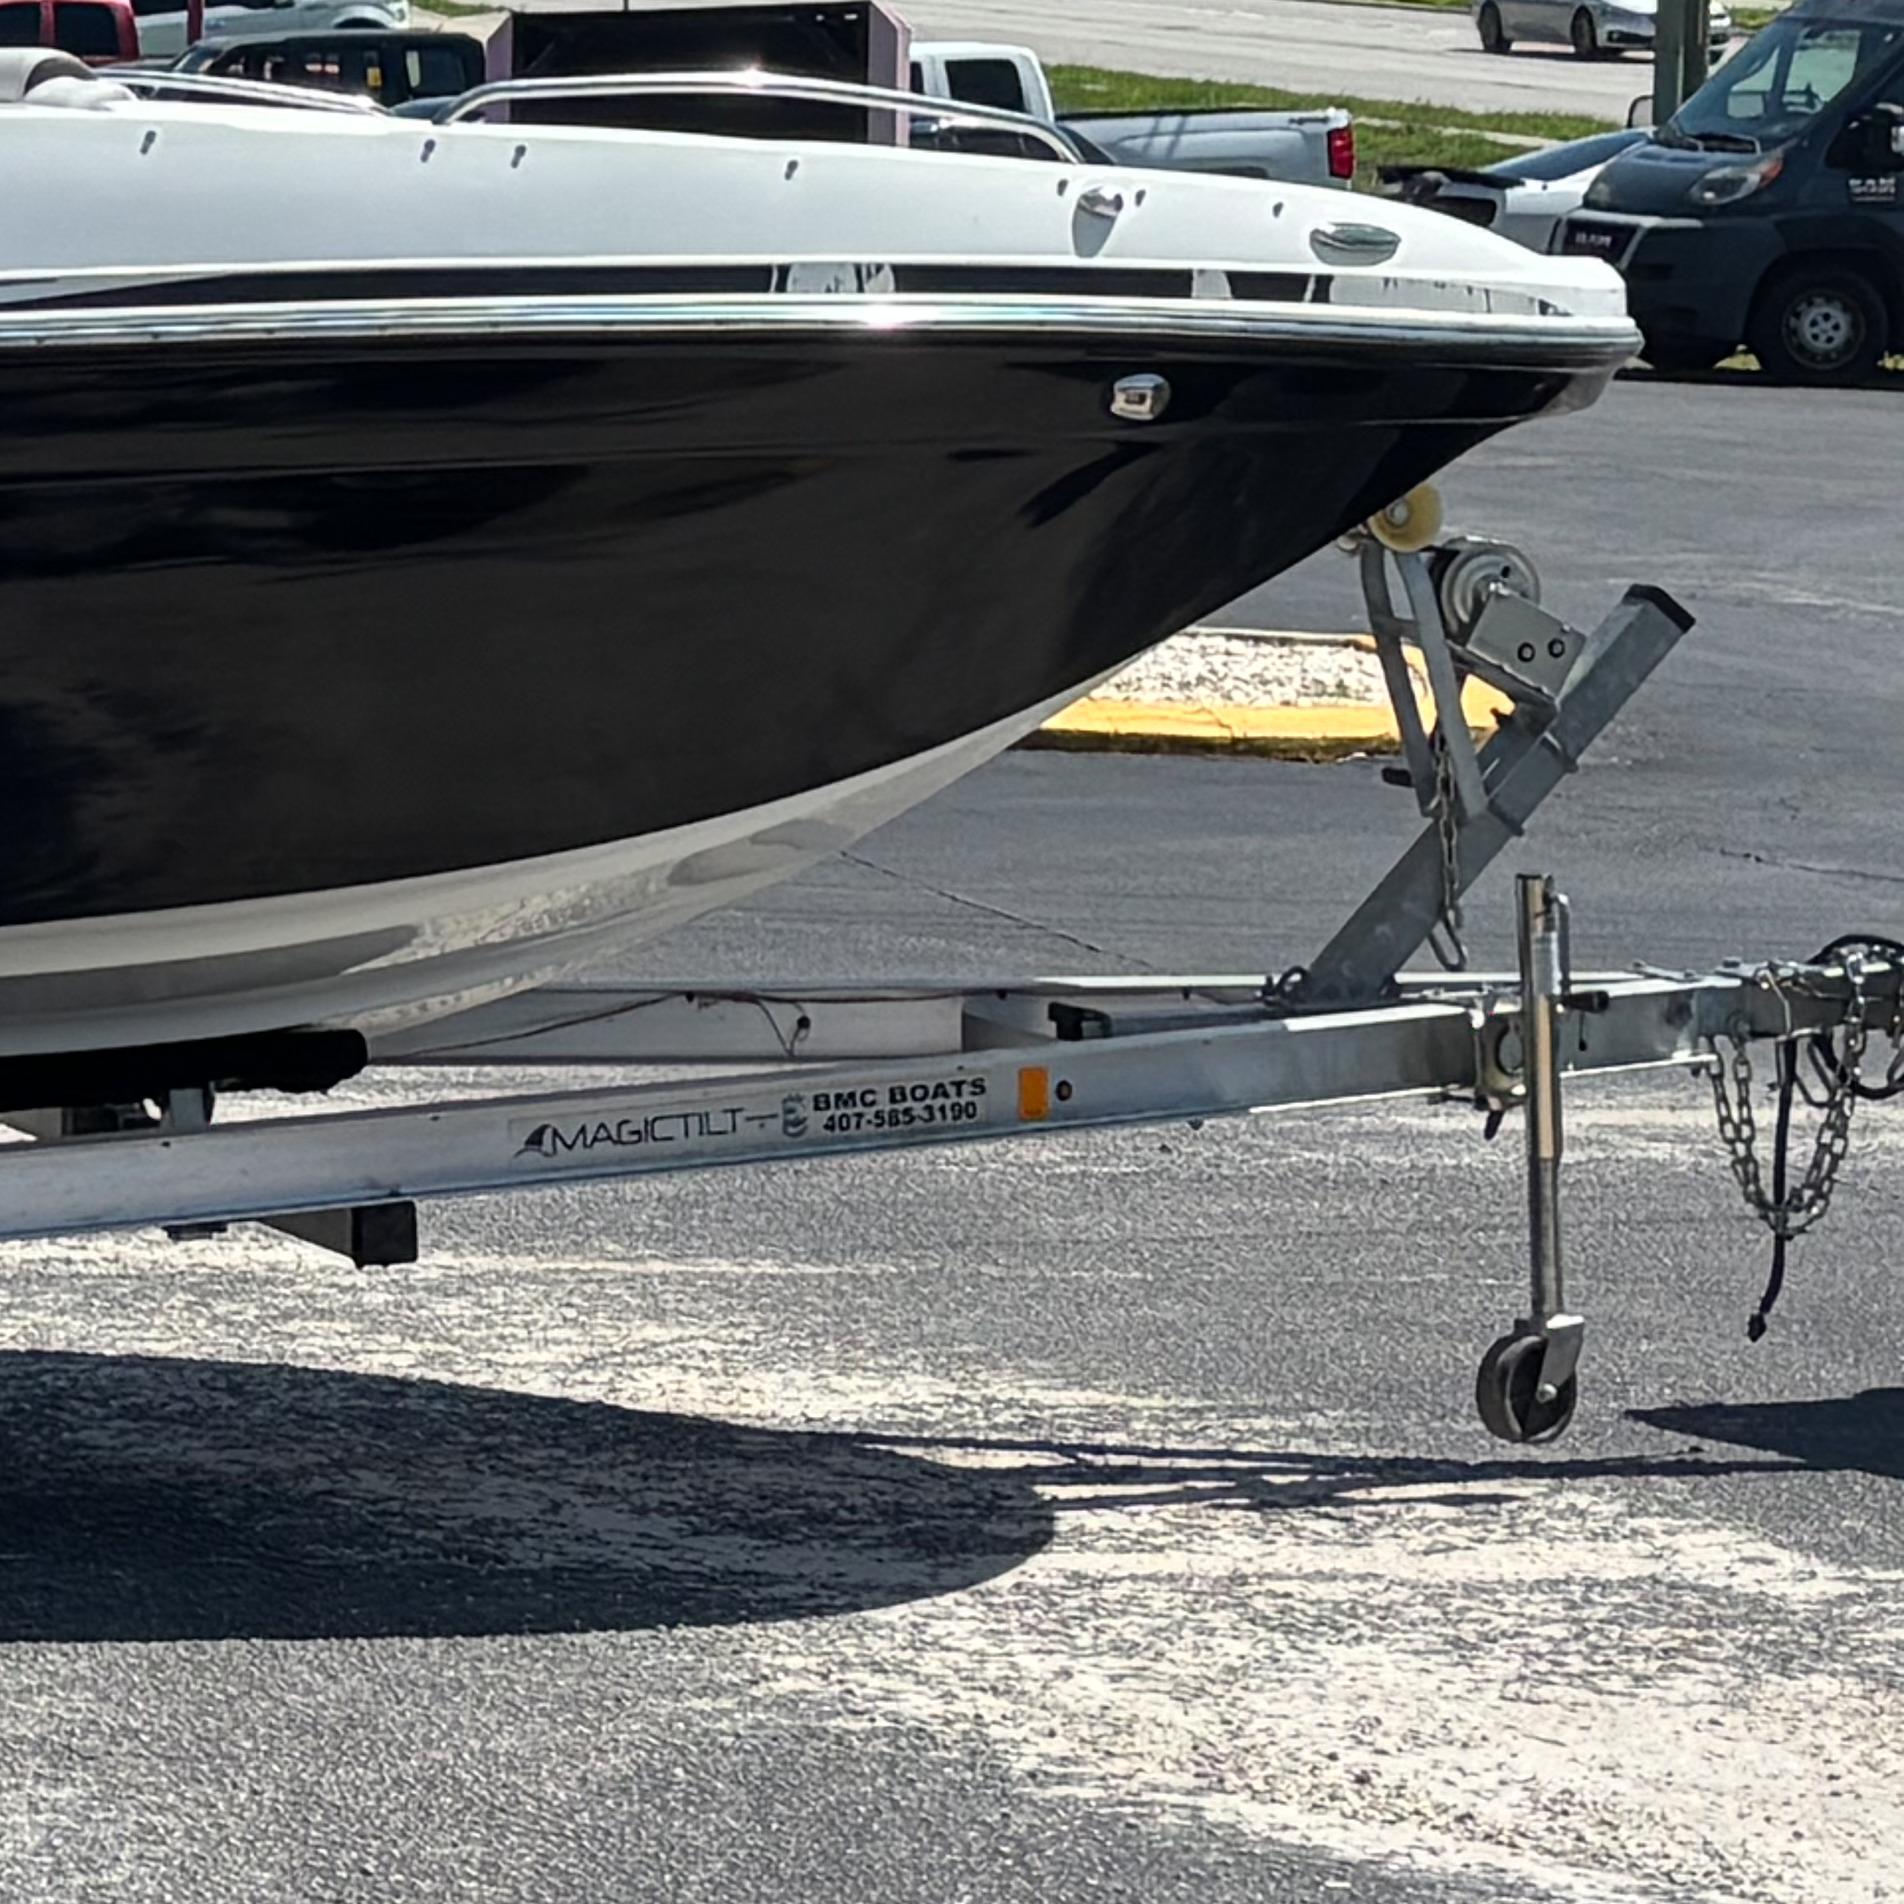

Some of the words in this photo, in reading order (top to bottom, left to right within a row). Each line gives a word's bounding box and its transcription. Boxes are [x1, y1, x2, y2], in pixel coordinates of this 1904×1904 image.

[813, 1089, 877, 1111] BMC
[889, 1077, 987, 1105] BOATS
[549, 1107, 744, 1154] MAGICTILT
